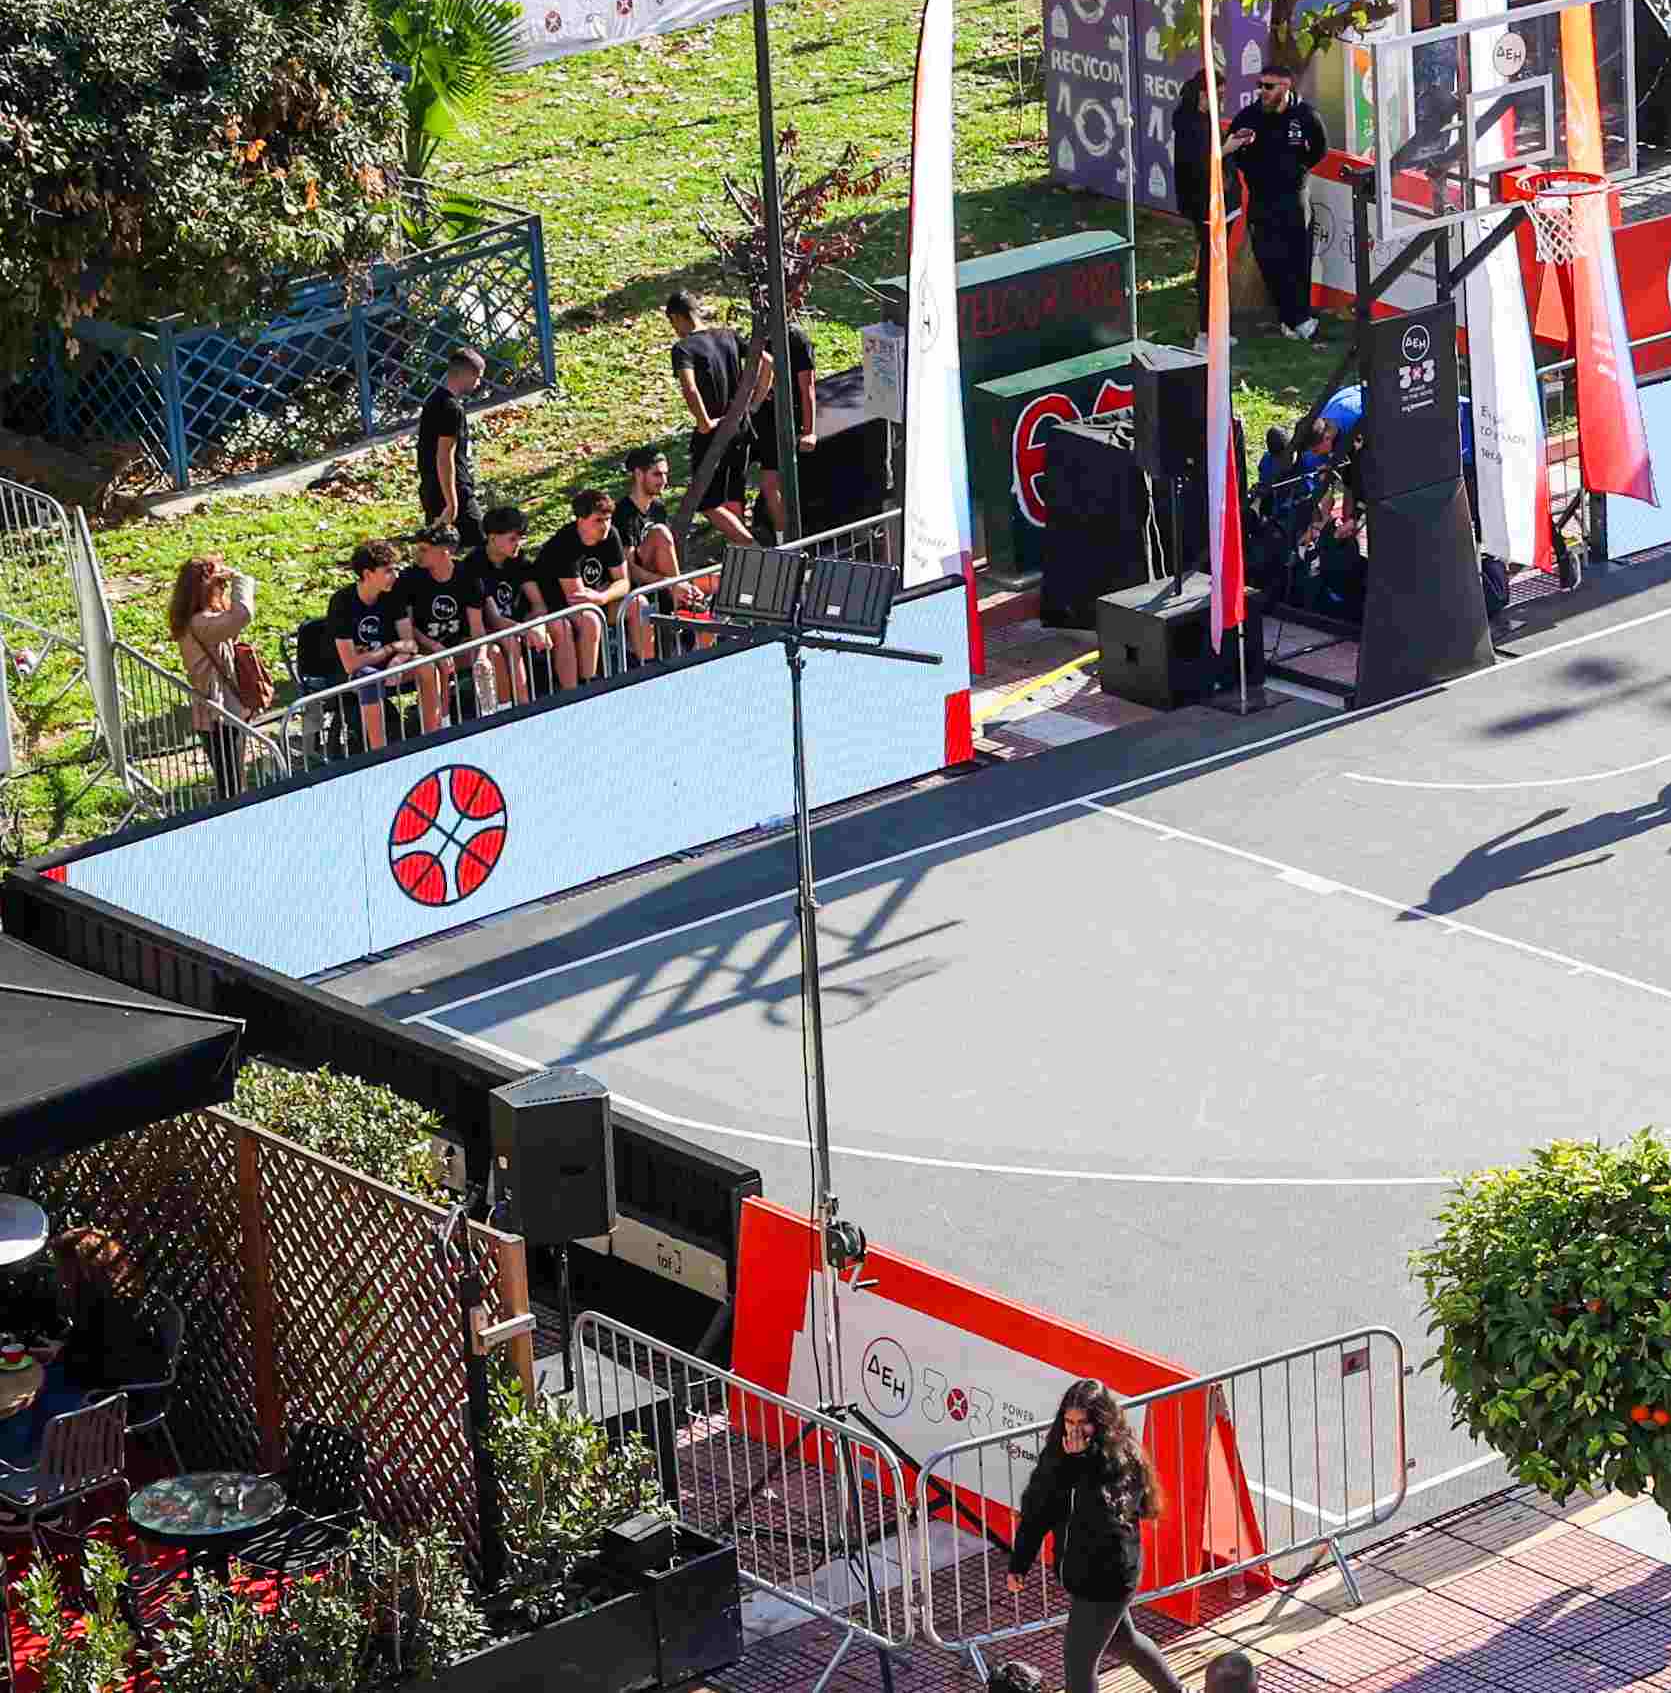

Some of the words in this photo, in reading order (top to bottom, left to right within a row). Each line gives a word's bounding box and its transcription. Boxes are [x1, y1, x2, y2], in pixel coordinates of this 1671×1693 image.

[1496, 45, 1520, 62] ΔΕΗ
[1145, 73, 1184, 102] RECY
[1312, 221, 1329, 243] ΕΗ
[1404, 335, 1426, 348] ΔΕΗ
[867, 1343, 906, 1401] ΔΕΗ
[1002, 1400, 1035, 1424] POWER
